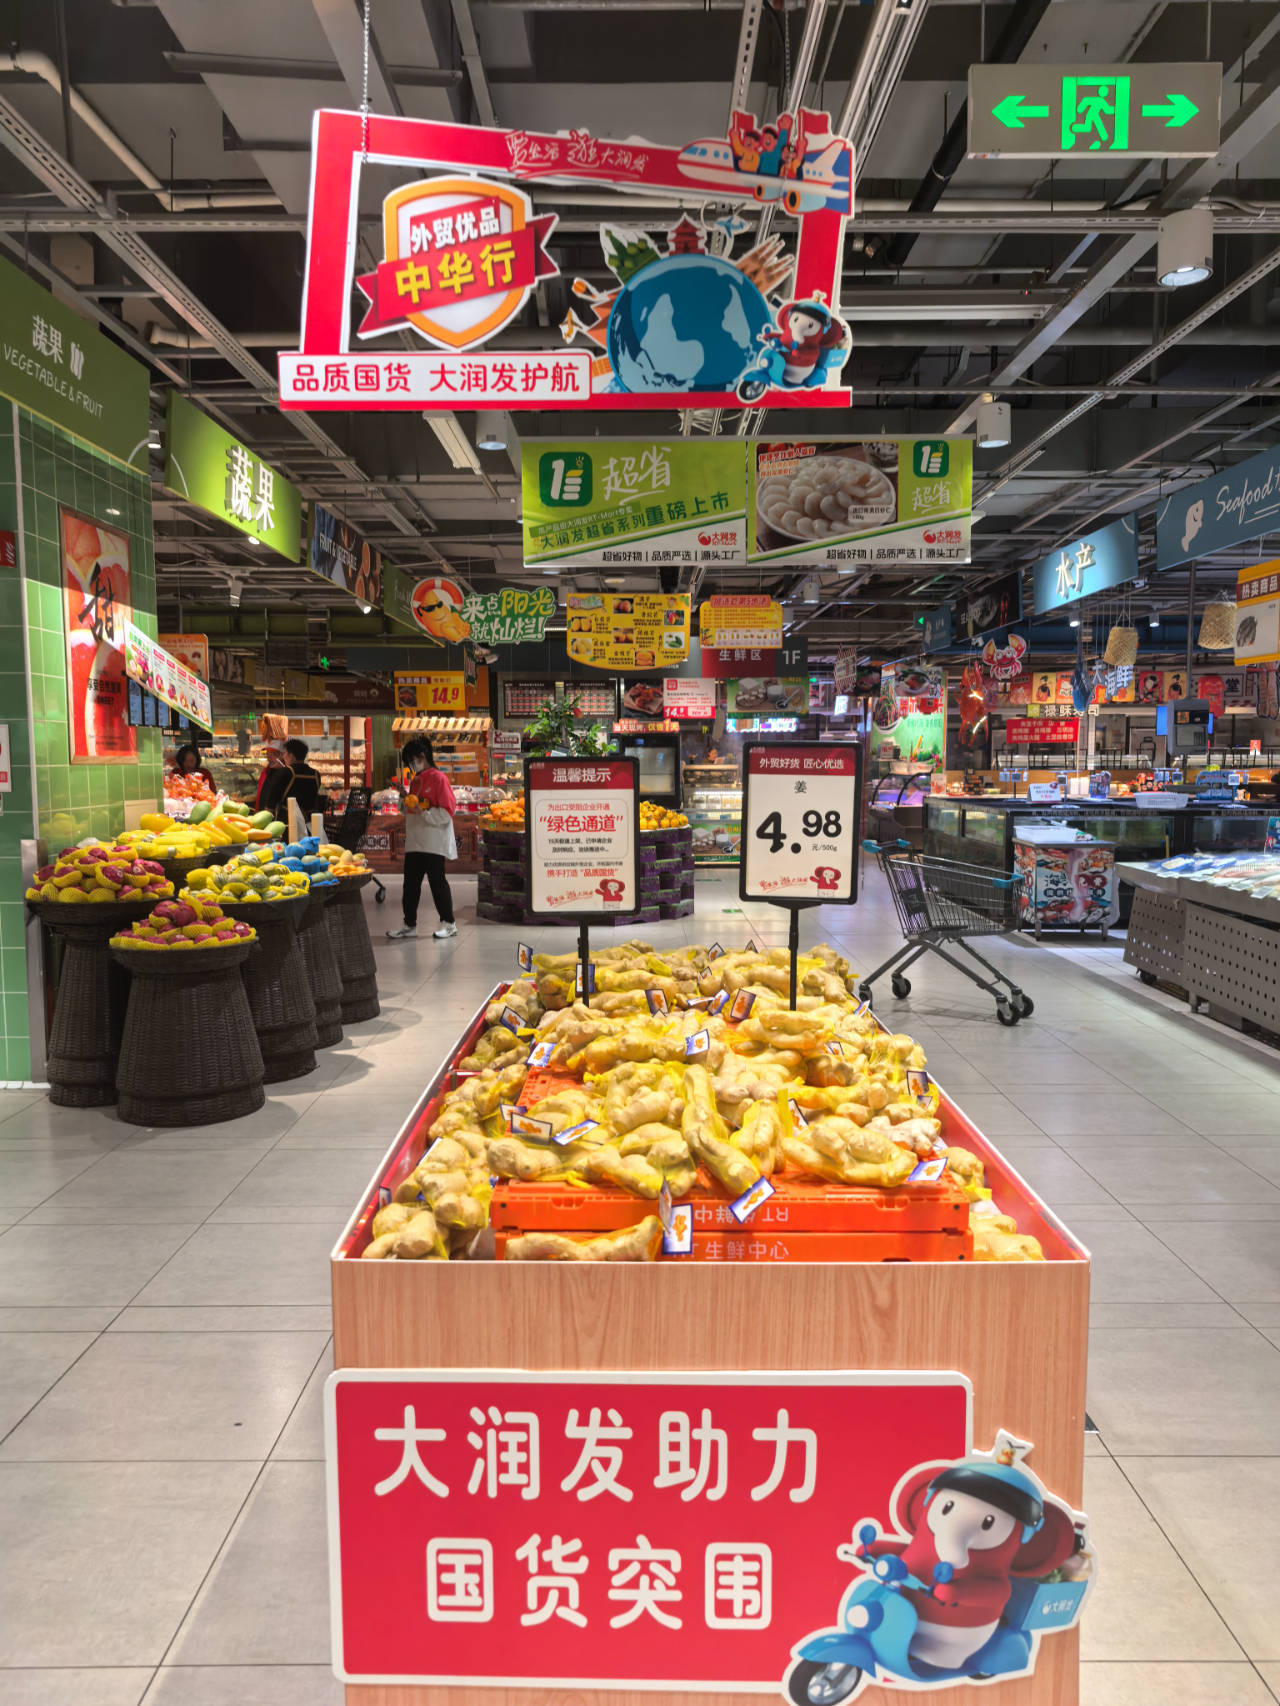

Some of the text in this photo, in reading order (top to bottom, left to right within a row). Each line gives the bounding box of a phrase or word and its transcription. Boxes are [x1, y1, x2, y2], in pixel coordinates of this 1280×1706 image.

[410, 206, 500, 254] 外贸优品
[395, 240, 516, 304] 中华行
[32, 314, 63, 364] 蔬果
[4, 343, 68, 398] VEGETABLE
[76, 391, 104, 419] FRUIT
[292, 362, 580, 393] 品质国货 大润发护航
[227, 445, 275, 531] 蔬果
[602, 446, 673, 501] 超省
[1216, 466, 1273, 525] Seafood
[541, 491, 729, 550] 大润发超省系列重磅上市
[602, 550, 741, 562] 超省好物 品质严选 源头工厂
[826, 548, 966, 560] 超省好物 品质严选 源头工厂
[1056, 542, 1096, 600] 水产
[461, 589, 553, 622] 来点阳光
[1241, 575, 1279, 599] 热卖商品
[718, 650, 801, 665] 生鲜区 1F
[431, 687, 460, 705] 14.9
[552, 767, 612, 783] 温馨提示
[759, 757, 845, 770] 外贸好货 匠心优选
[794, 780, 807, 794] 姜
[756, 809, 842, 854] 4.98
[705, 1241, 789, 1260] 生鲜中心
[374, 1404, 818, 1503] 大润发助力
[426, 1534, 772, 1630] 国货突围
